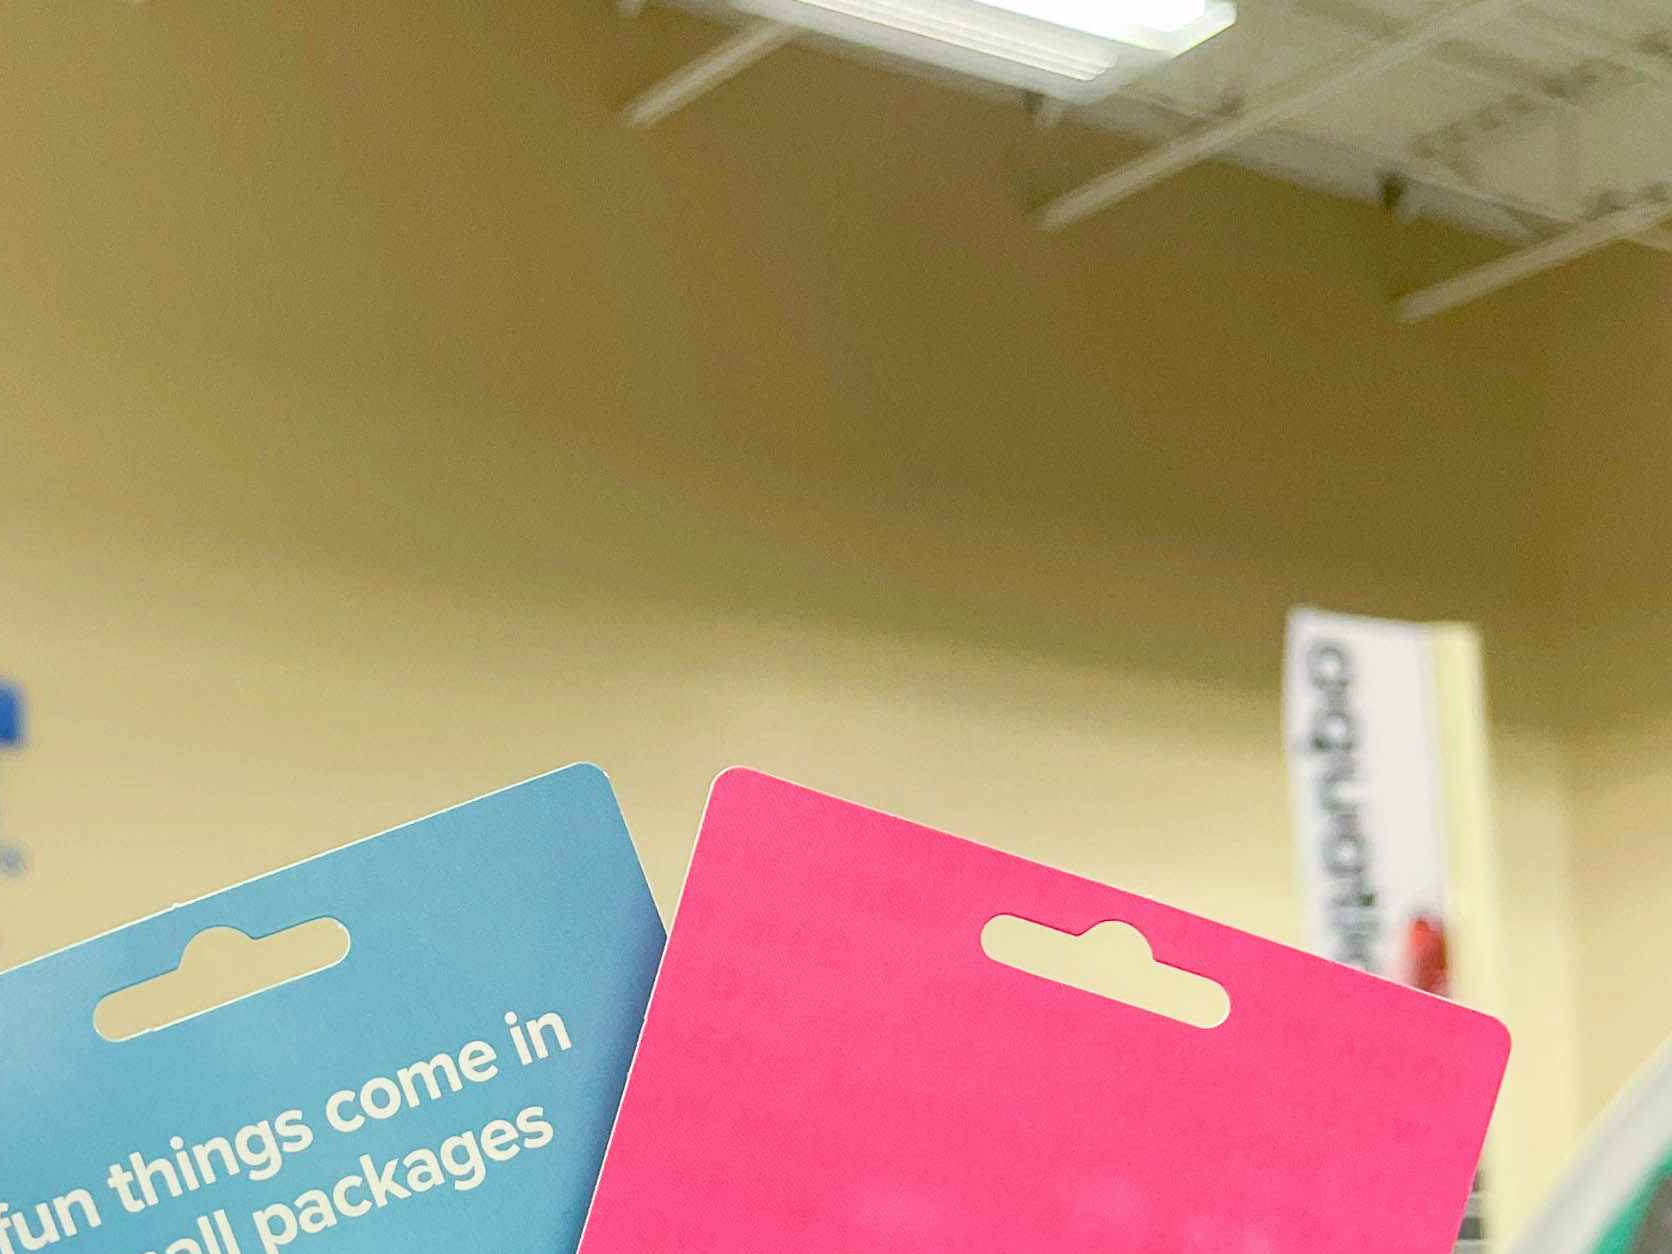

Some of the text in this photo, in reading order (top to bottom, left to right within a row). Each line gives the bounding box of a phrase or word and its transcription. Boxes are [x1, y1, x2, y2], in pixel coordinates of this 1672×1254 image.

[108, 1109, 314, 1214] things
[325, 1040, 500, 1133] come
[504, 1010, 573, 1066] in
